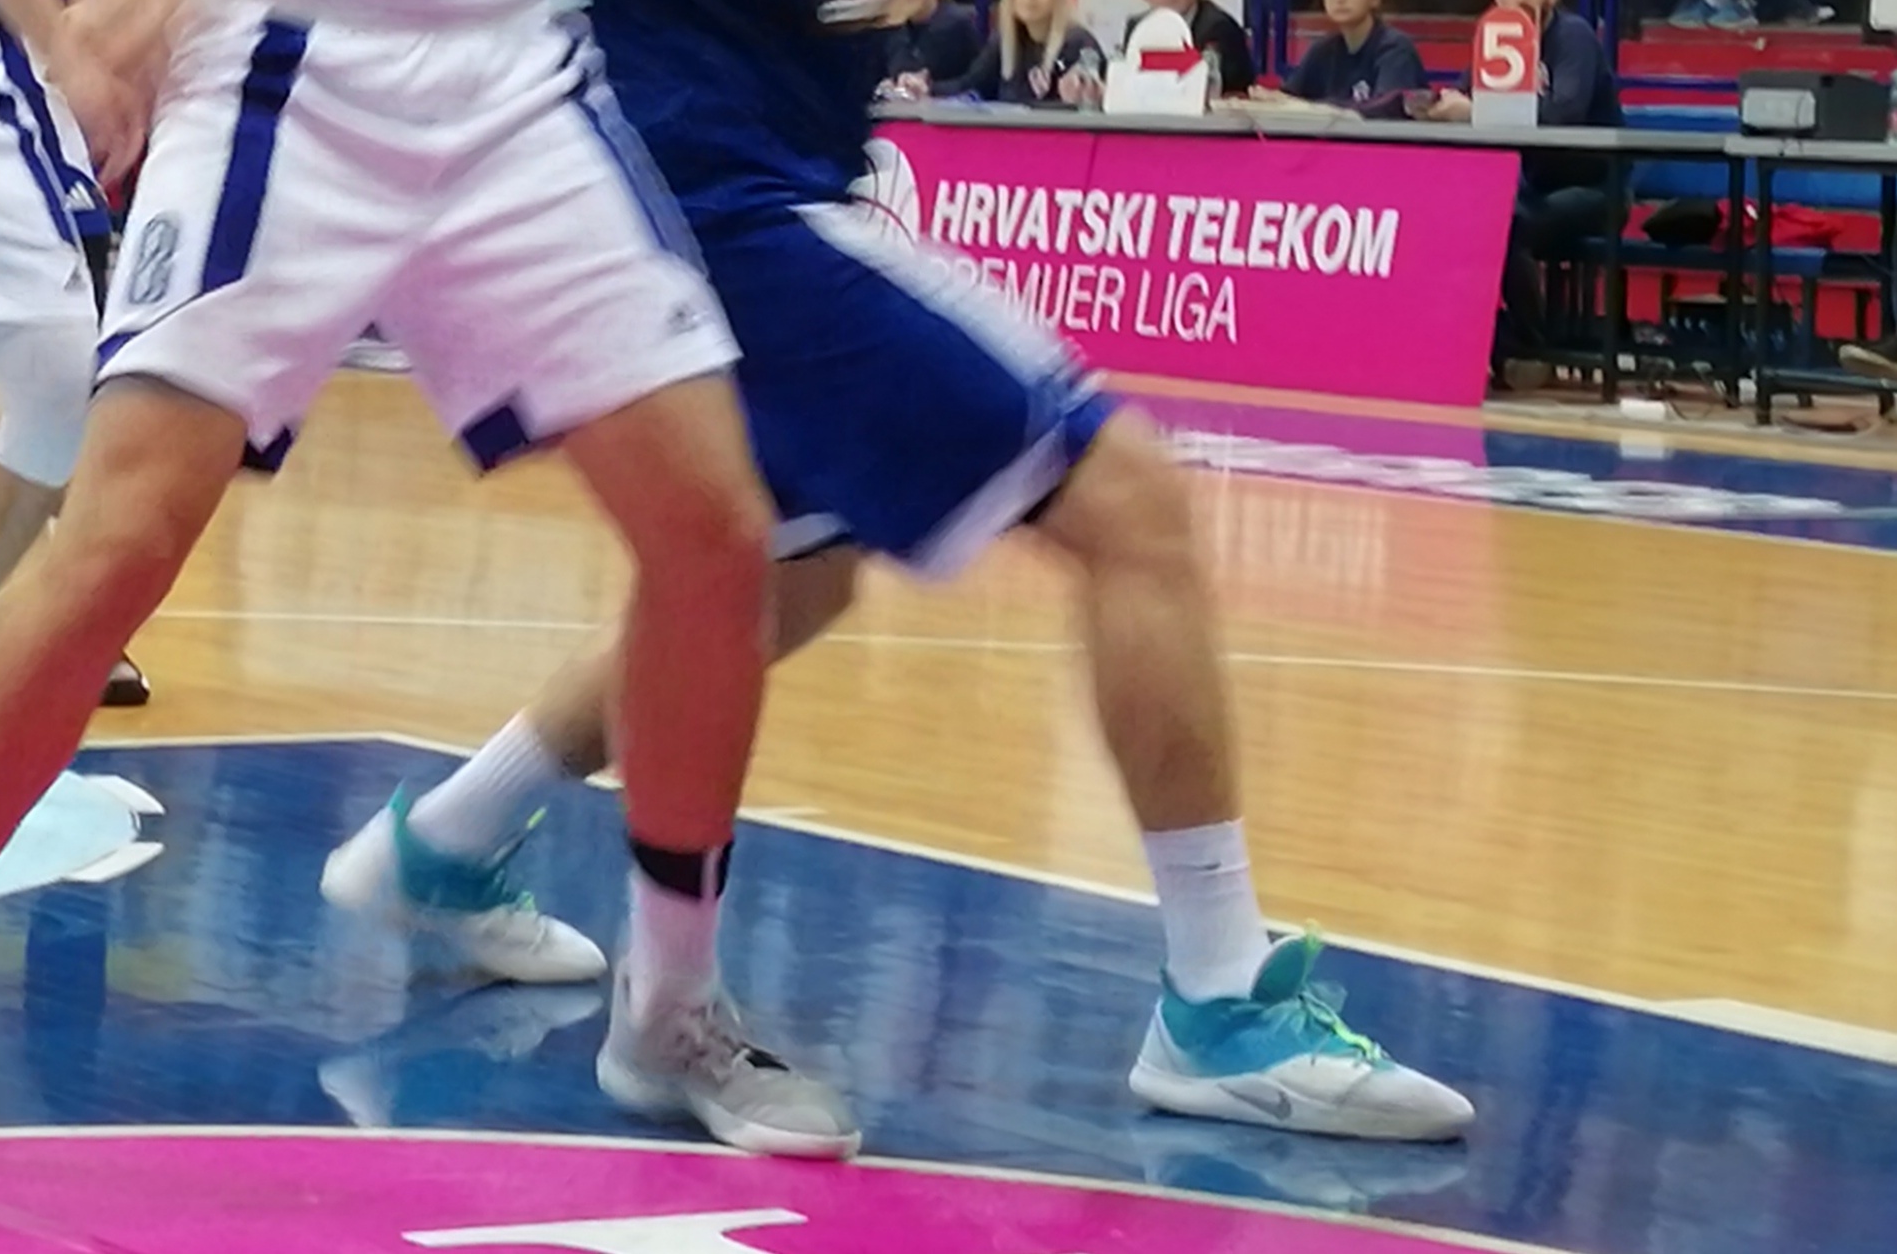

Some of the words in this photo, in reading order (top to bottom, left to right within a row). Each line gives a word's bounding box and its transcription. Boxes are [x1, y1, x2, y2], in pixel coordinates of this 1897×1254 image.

[1479, 22, 1525, 90] 5
[128, 210, 181, 306] 8
[930, 178, 1158, 259] HRVATSKI
[1165, 193, 1400, 278] TELEKOM
[1134, 266, 1239, 344] LIGA
